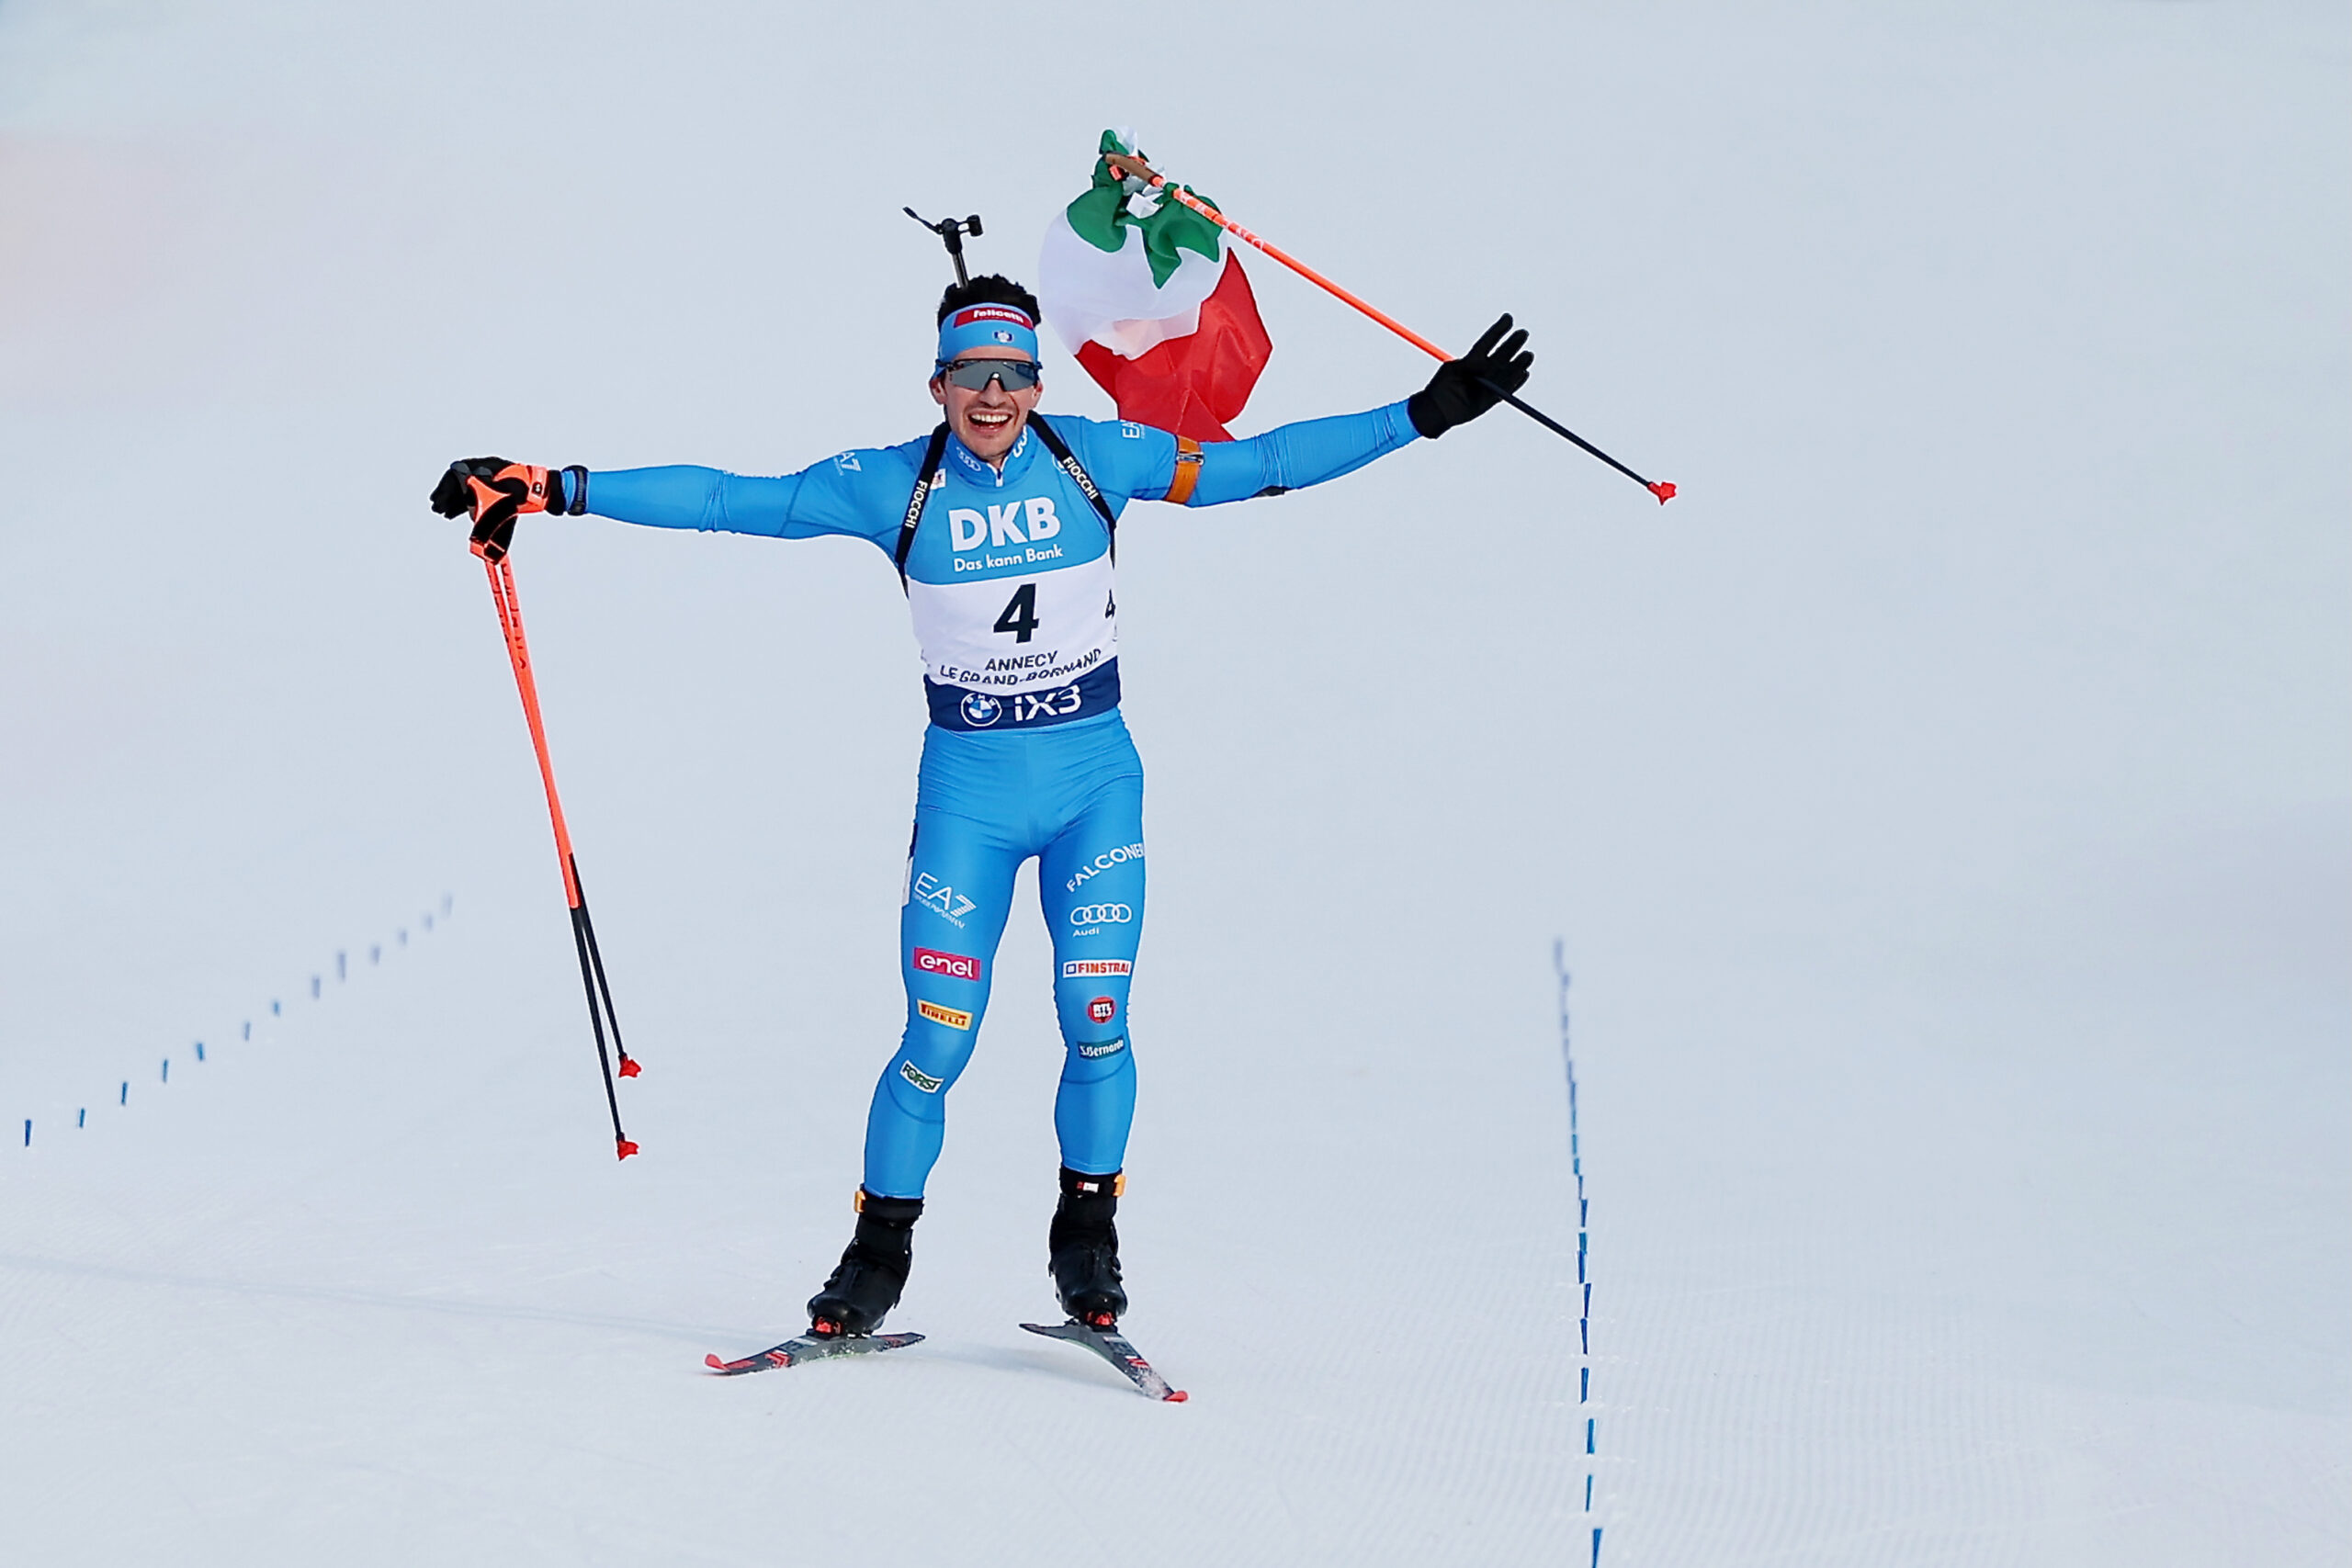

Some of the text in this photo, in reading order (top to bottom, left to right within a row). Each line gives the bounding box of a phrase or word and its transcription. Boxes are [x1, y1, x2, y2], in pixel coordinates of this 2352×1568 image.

[1121, 419, 1144, 439] EA
[841, 451, 863, 472] A7
[1062, 456, 1099, 501] FIOCCHI
[904, 479, 928, 529] FIOCCHI
[947, 497, 1061, 553] DKB
[954, 545, 1064, 573] Das kann Bank
[992, 582, 1040, 645] 4
[940, 664, 957, 681] LE
[984, 650, 1058, 671] ANNECY
[1014, 684, 1082, 722] iX3
[1066, 842, 1144, 893] FALCONE
[914, 872, 977, 919] EA7
[1072, 927, 1100, 937] Audi
[920, 954, 974, 978] enel
